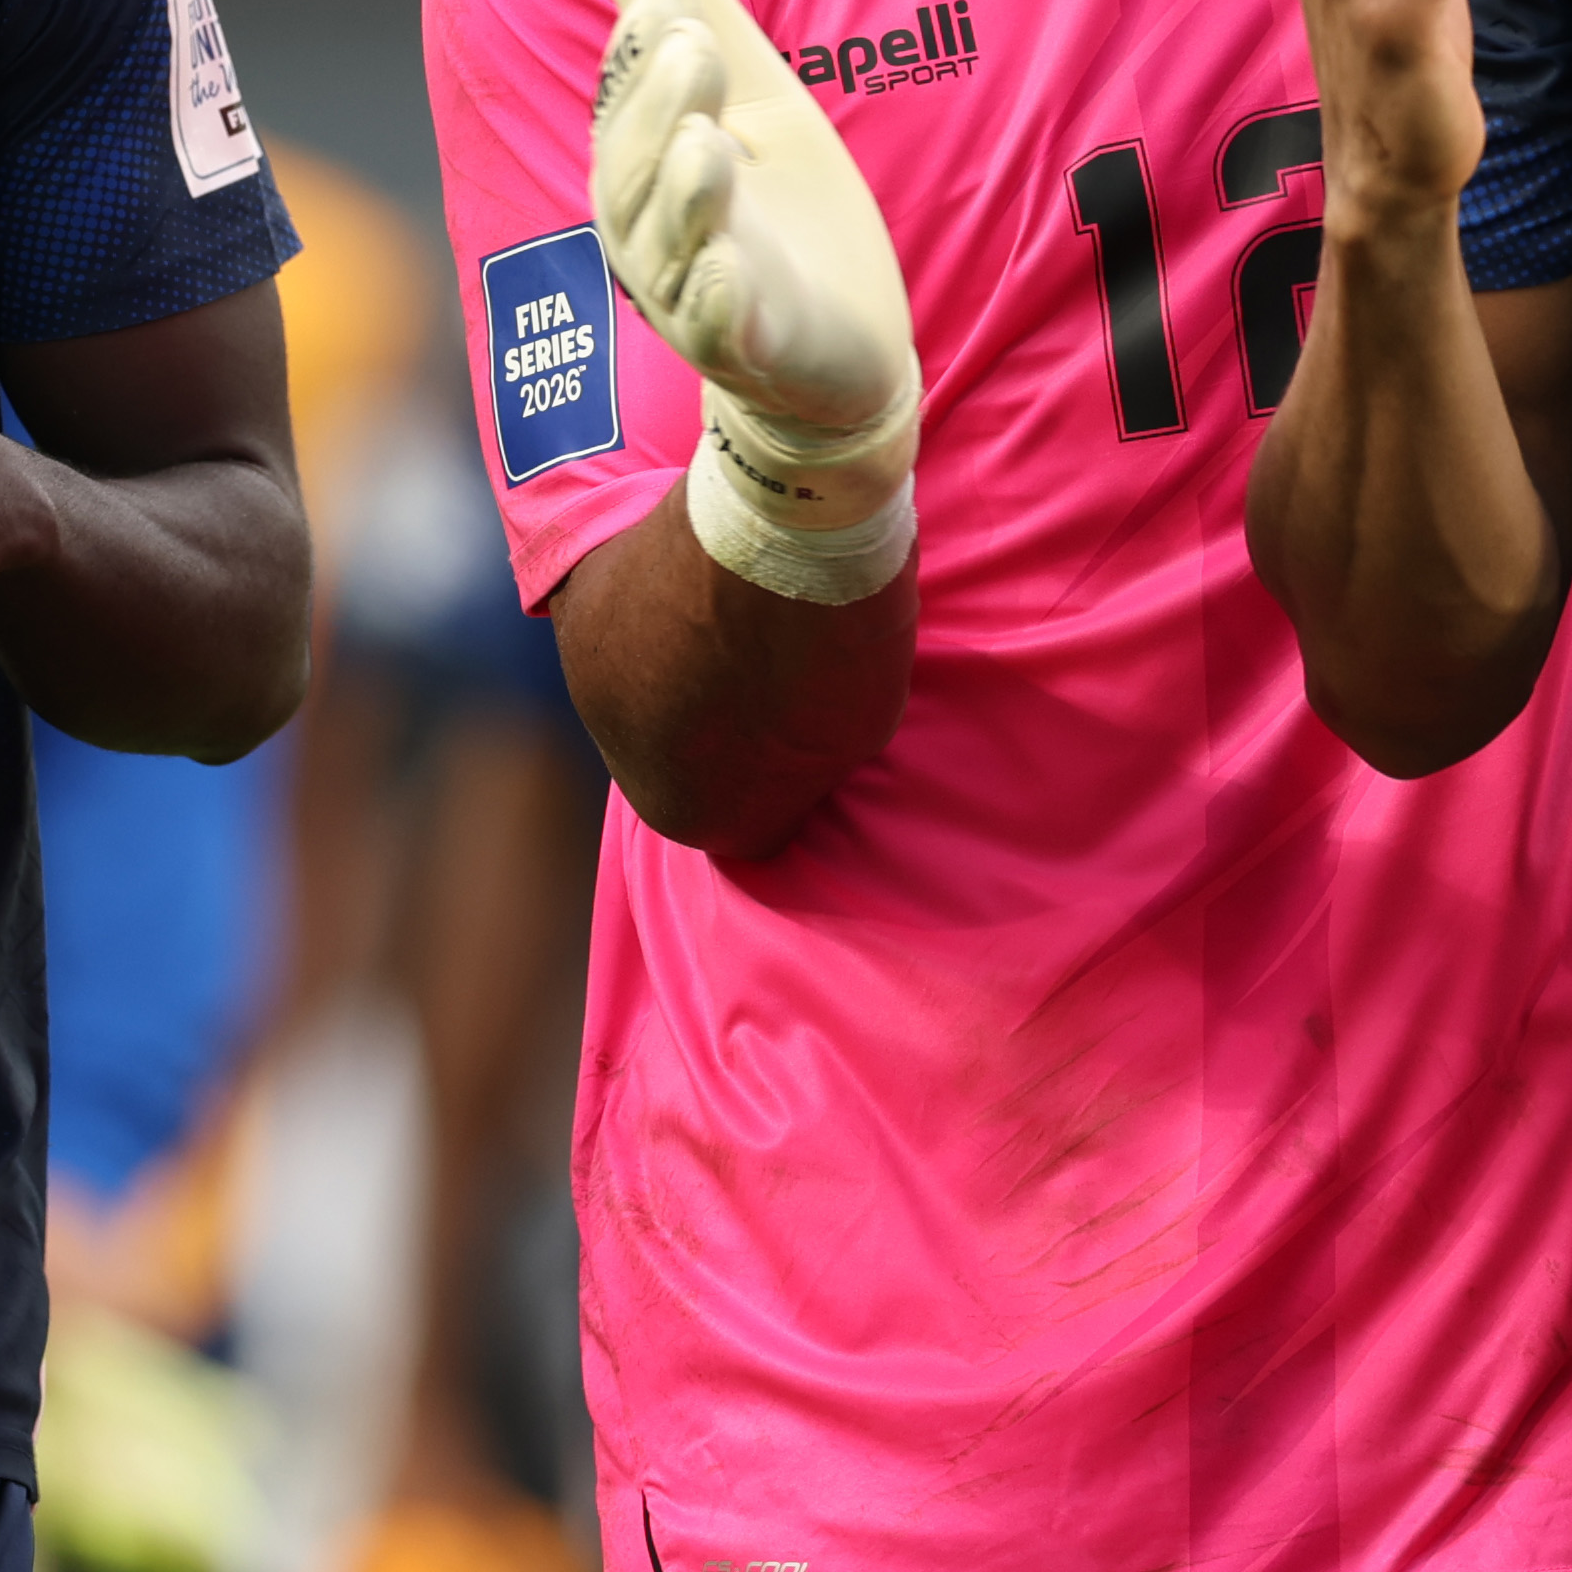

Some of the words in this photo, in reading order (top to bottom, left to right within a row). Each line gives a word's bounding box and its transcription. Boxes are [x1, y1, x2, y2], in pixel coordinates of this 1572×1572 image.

[781, 0, 978, 95] apelli
[864, 55, 980, 96] SPORT
[1063, 99, 1325, 443] 12
[515, 291, 575, 339] FIFA
[504, 324, 595, 383] SERIES
